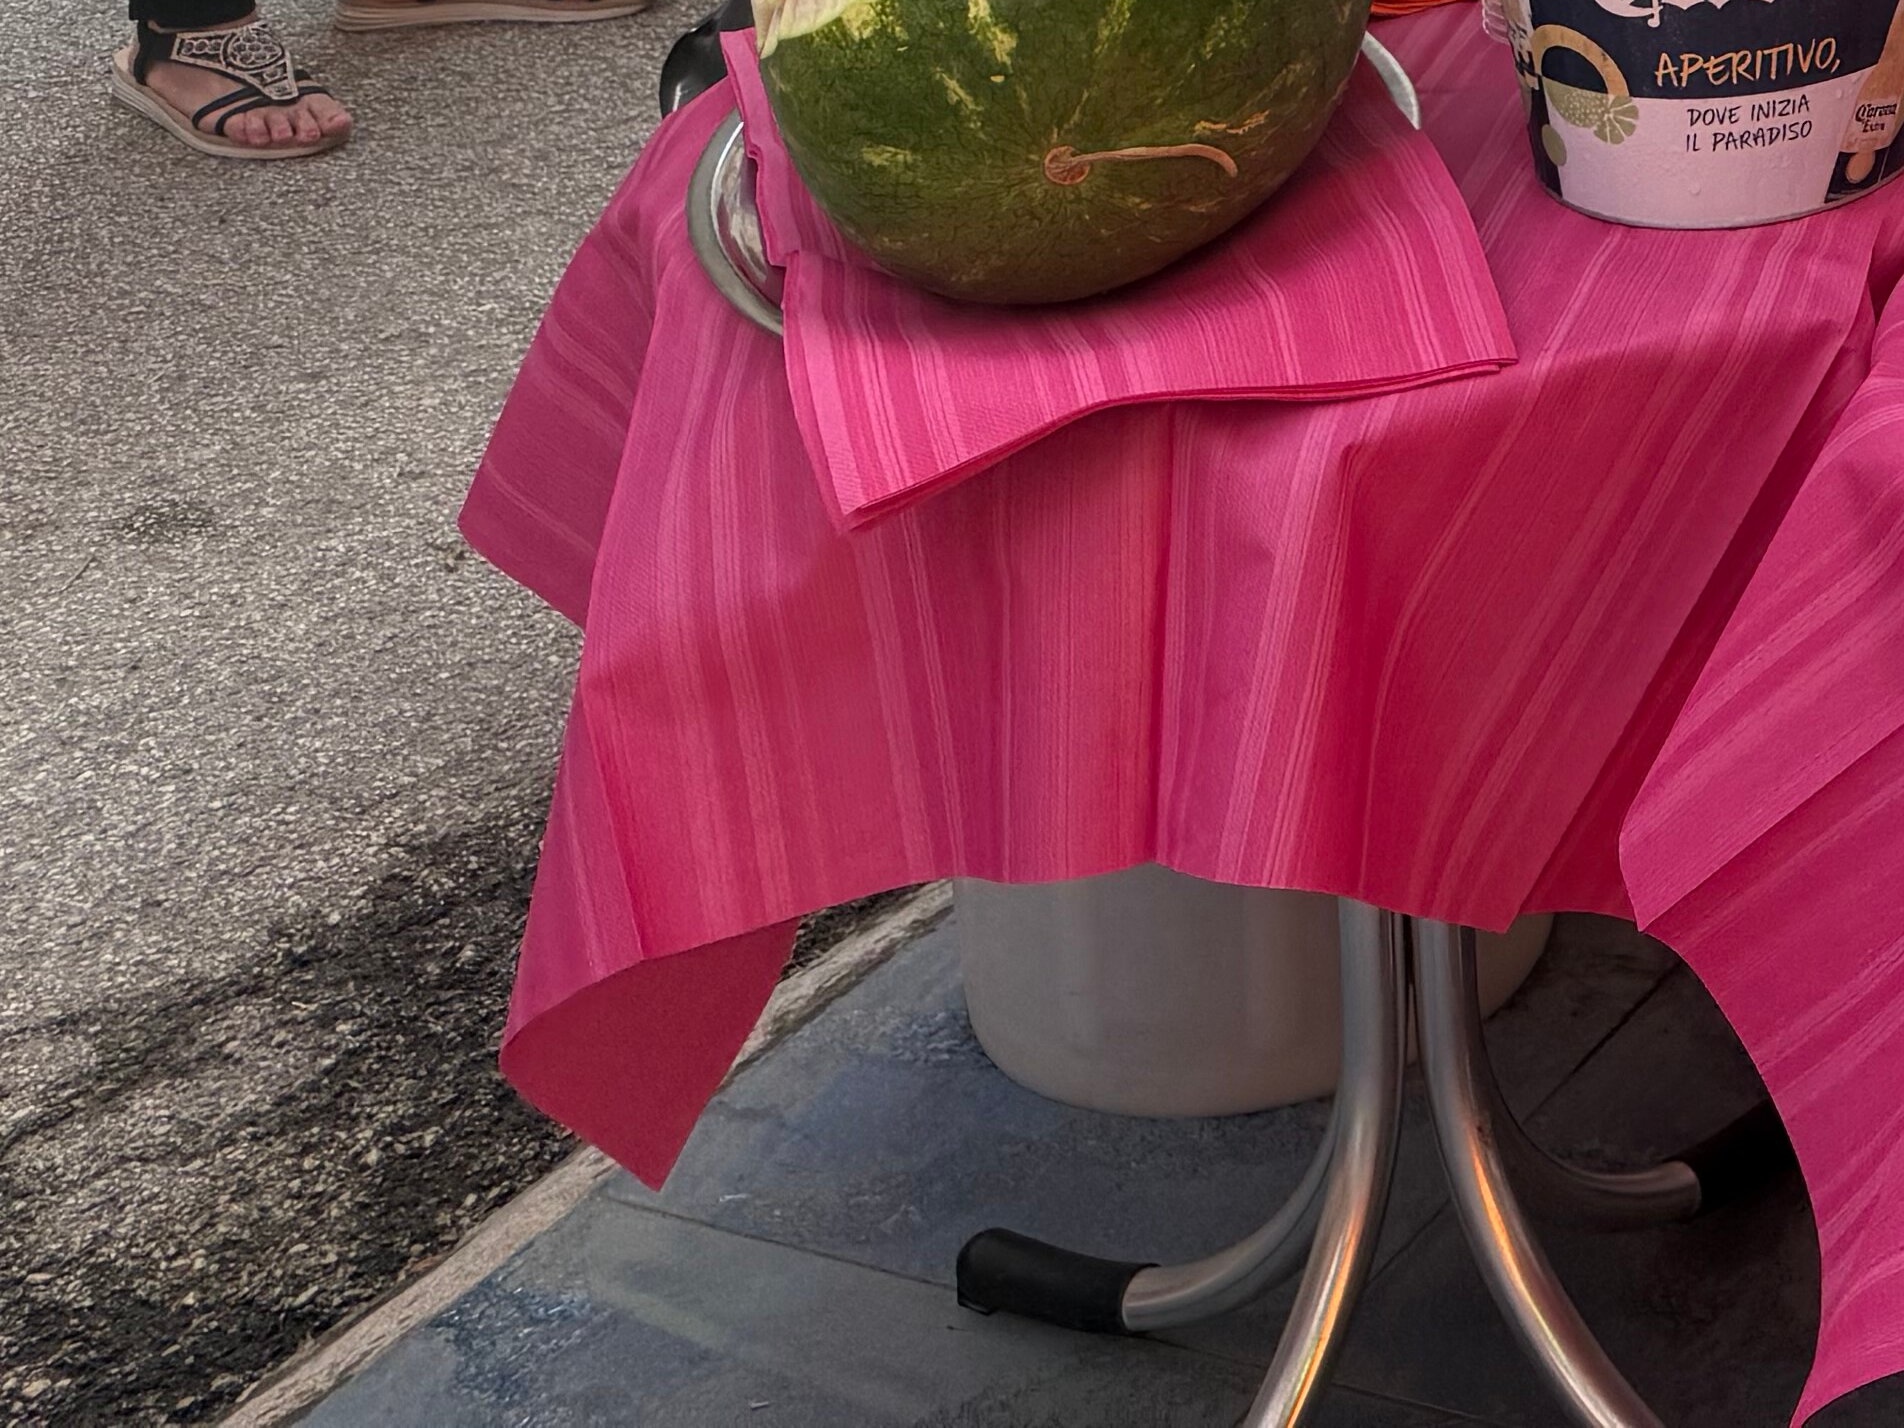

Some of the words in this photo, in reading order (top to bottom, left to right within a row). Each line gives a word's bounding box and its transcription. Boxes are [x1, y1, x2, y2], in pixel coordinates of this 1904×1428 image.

[1687, 104, 1740, 128] DOVE
[1749, 94, 1811, 120] INIZIA
[1685, 132, 1702, 152] IL
[1712, 119, 1813, 152] PARADISO
